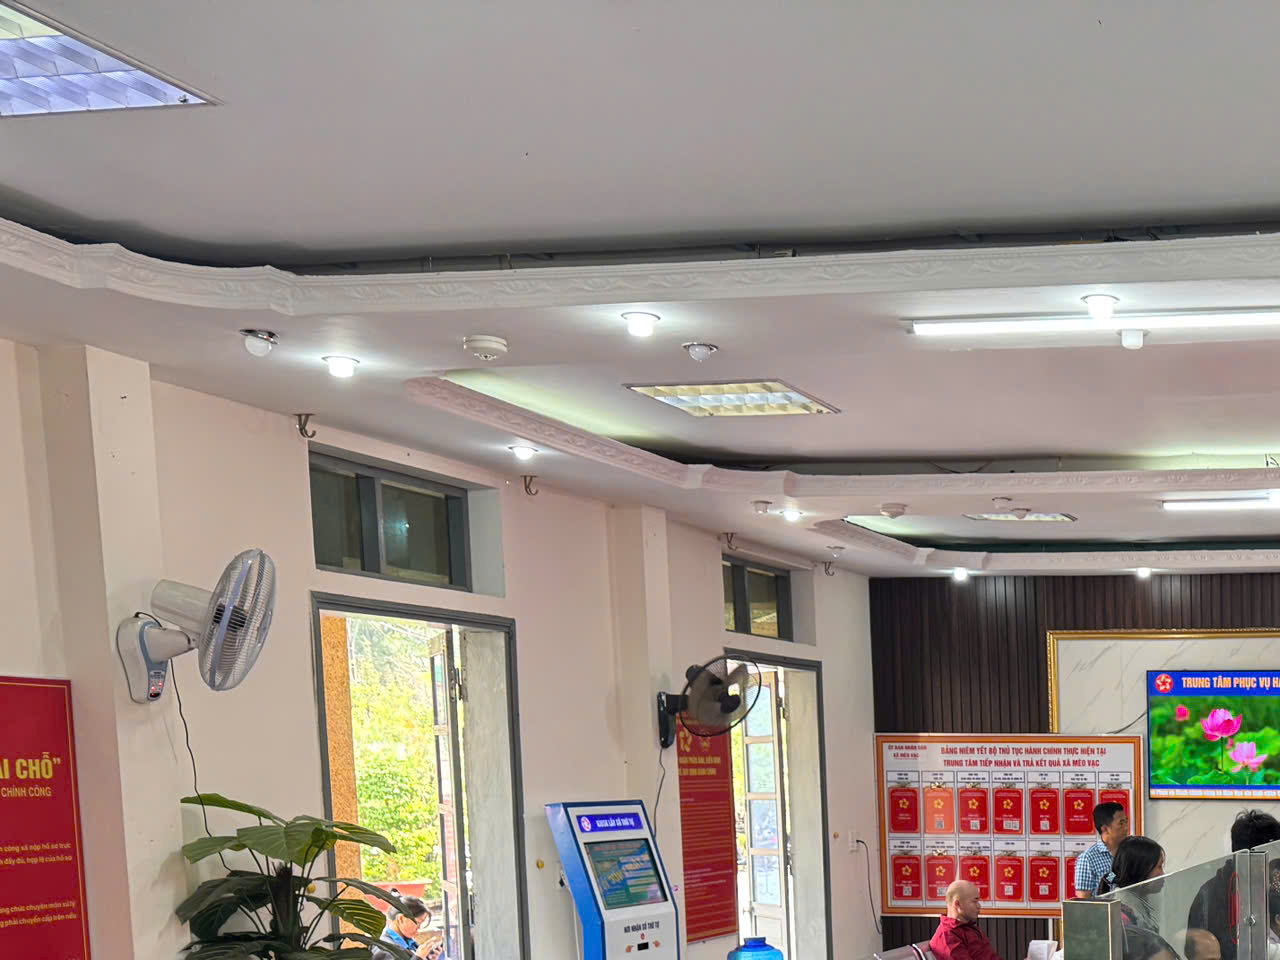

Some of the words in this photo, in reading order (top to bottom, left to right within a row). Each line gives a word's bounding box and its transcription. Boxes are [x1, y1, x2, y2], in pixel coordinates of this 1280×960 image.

[1181, 676, 1211, 688] TRUNG
[1213, 674, 1232, 688] TÂM
[1233, 676, 1257, 691] PHỤC
[1259, 676, 1271, 690] VỤ
[941, 746, 958, 755] BẢNG
[959, 746, 975, 755] NIÊM
[977, 745, 987, 755] YẾT
[989, 746, 997, 756] BỘ
[999, 745, 1010, 755] THỦ
[1012, 747, 1023, 756] TỤC
[1025, 745, 1042, 755] HÀNH
[1043, 746, 1062, 755] CHÍNH
[1064, 746, 1079, 756] THỰC
[1080, 746, 1095, 756] HIỆN
[1097, 746, 1106, 757] TẠI
[944, 759, 963, 767] TRUNG
[965, 758, 978, 767] TÂM
[980, 758, 992, 767] TIẾP
[994, 759, 1011, 768] NHẬN
[1013, 758, 1021, 767] VÀ
[1023, 758, 1034, 767] TRẢ
[1036, 758, 1047, 767] KẾT
[1048, 758, 1060, 768] QUẢ
[1063, 758, 1071, 767] XÃ
[1088, 759, 1100, 768] VẠC
[1, 785, 26, 798] CHÍNH
[28, 784, 52, 797] CÔNG
